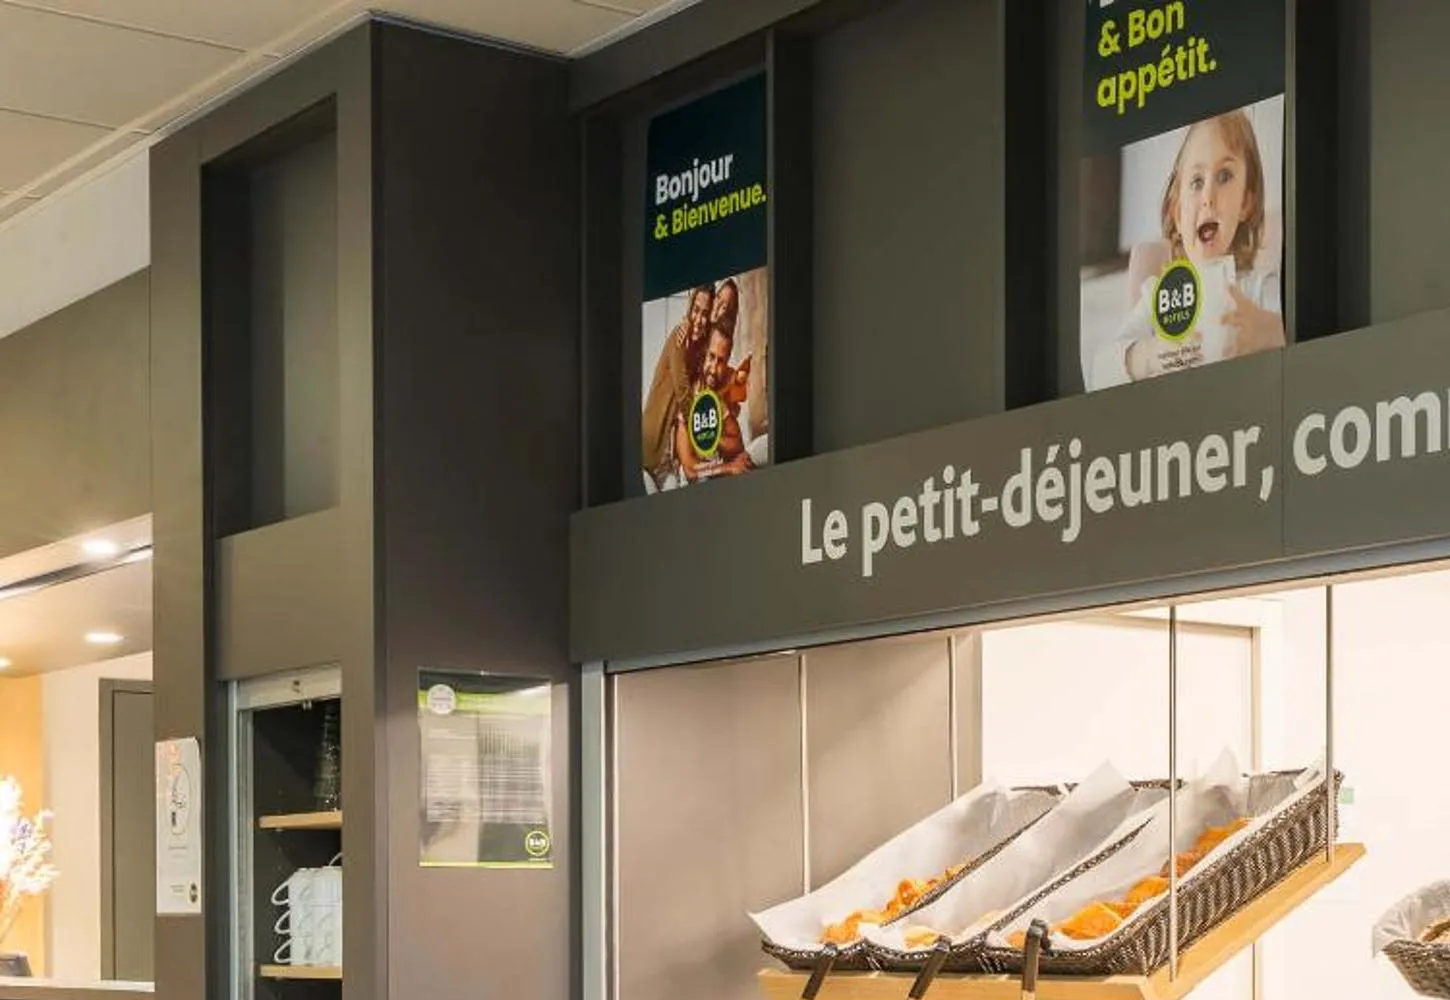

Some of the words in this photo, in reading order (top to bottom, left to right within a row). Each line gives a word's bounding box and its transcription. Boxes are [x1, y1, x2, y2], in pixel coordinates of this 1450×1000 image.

[1098, 20, 1120, 57] &
[1128, 1, 1184, 48] Bon
[1097, 36, 1217, 115] appétit.
[655, 153, 734, 205] Bonjour
[654, 213, 669, 240] &
[672, 183, 767, 235] Bienvenue.
[1158, 282, 1195, 314] B&B
[693, 408, 718, 433] B&B
[801, 497, 849, 565] Le
[862, 425, 1275, 577] petit-déjeuner,
